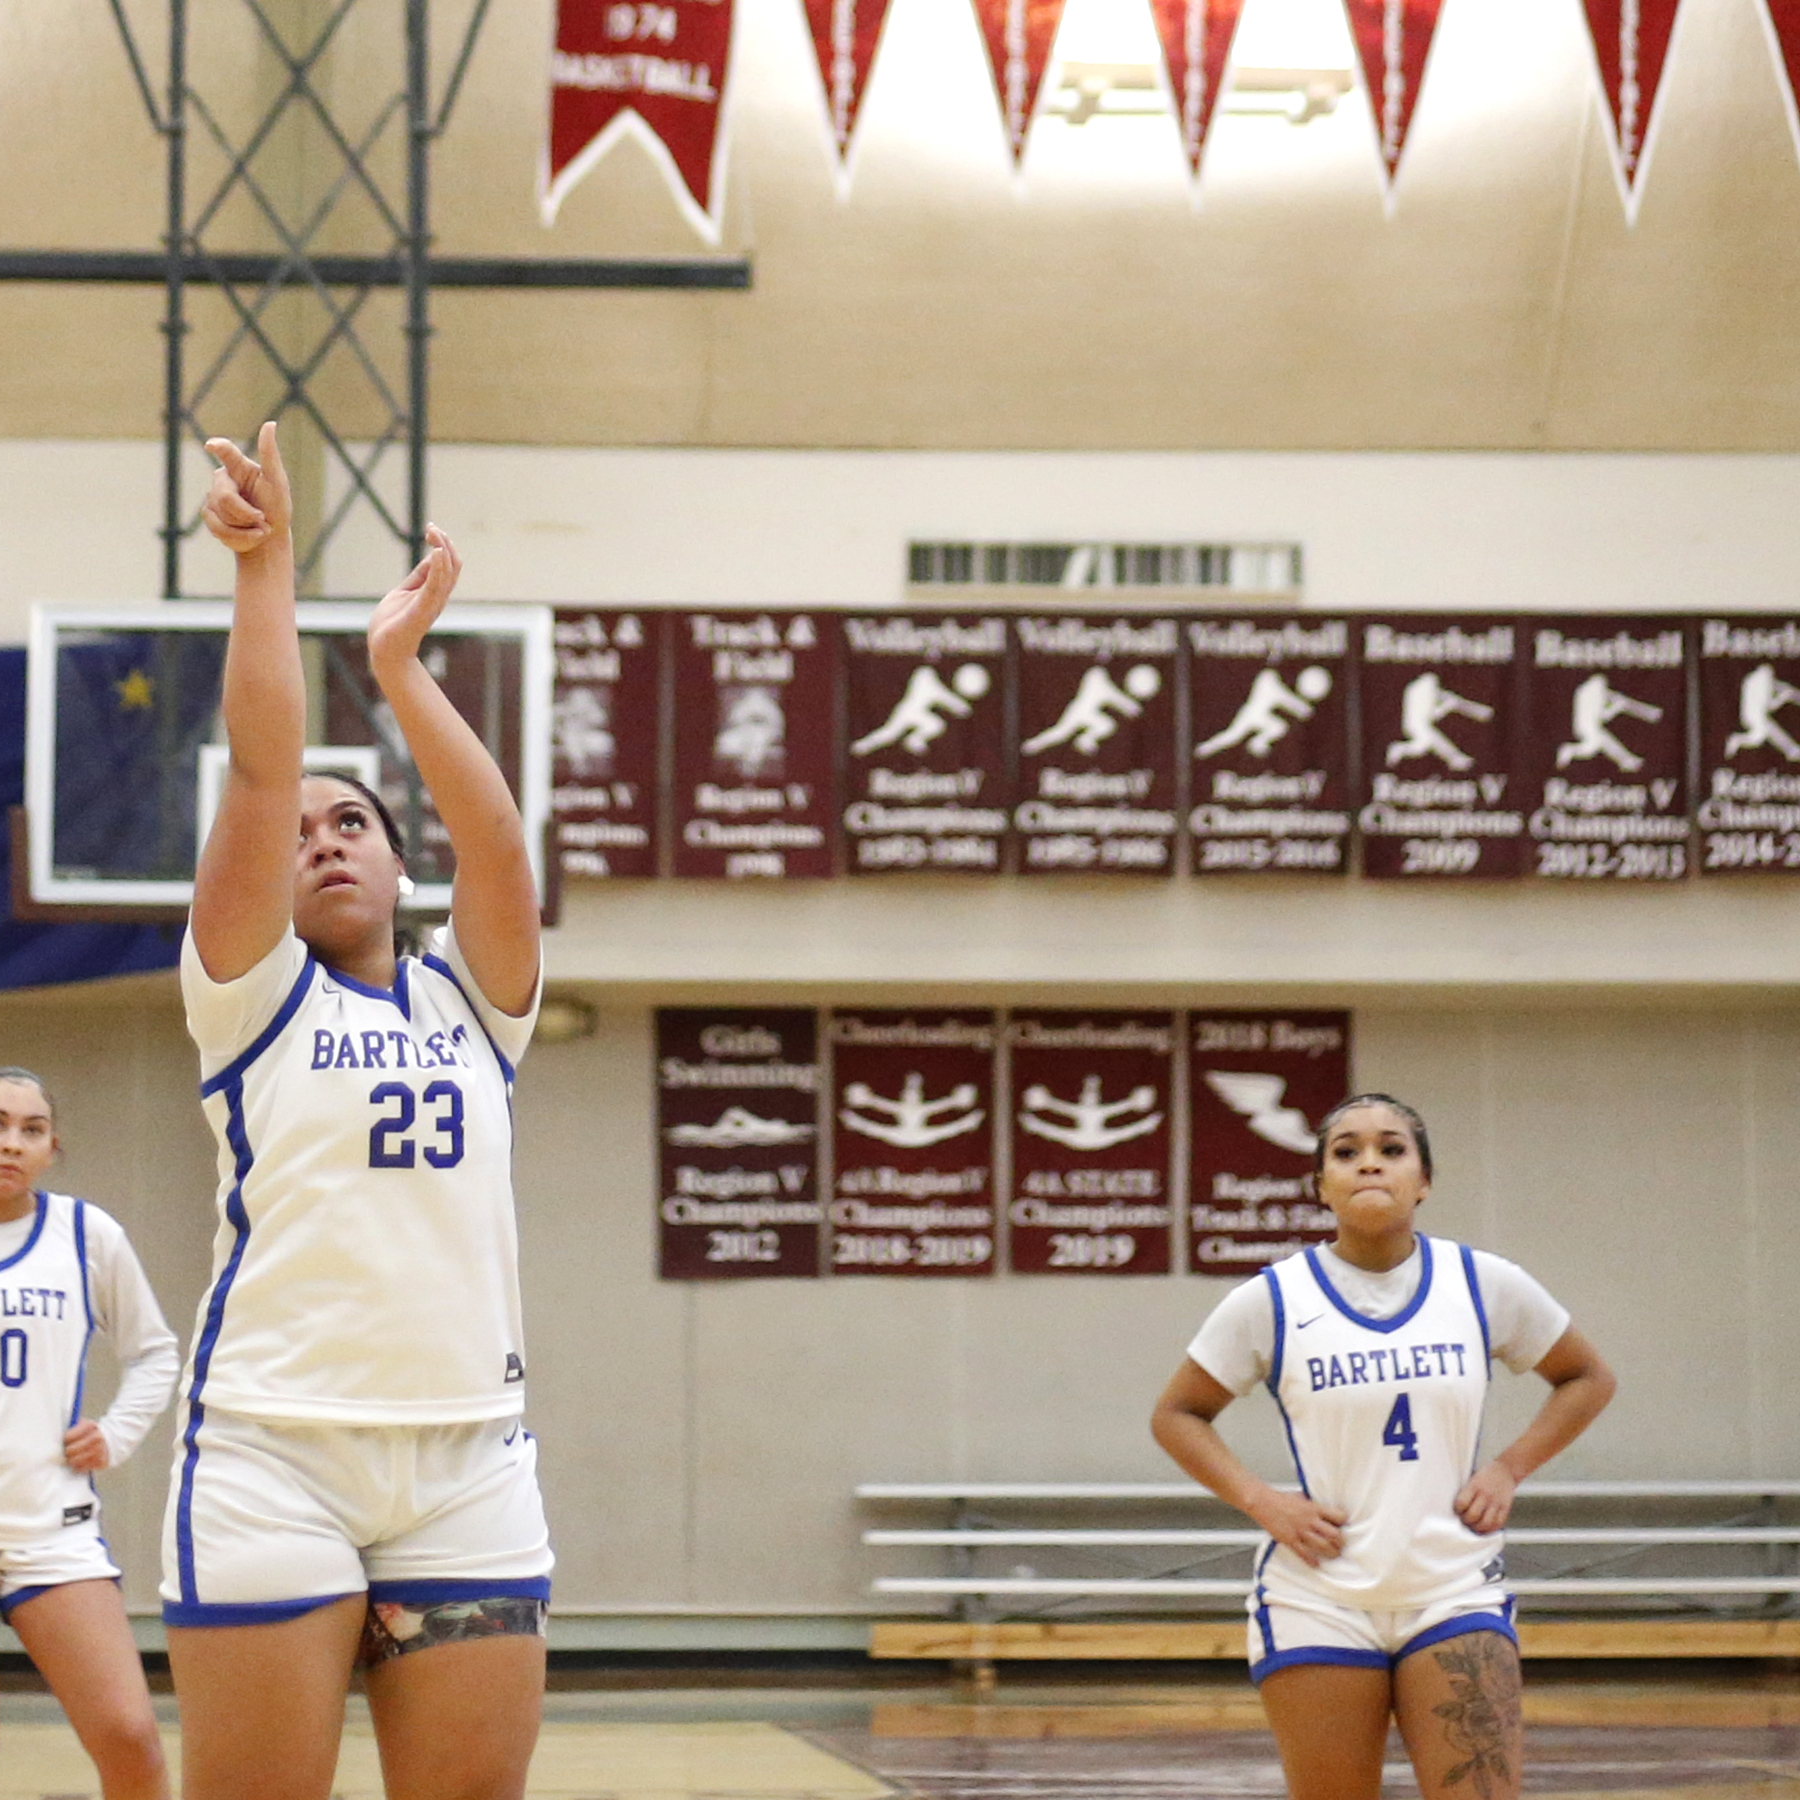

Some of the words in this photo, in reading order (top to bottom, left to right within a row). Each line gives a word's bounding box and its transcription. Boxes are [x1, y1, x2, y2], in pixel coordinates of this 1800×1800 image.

[844, 617, 1006, 663] Volleyball
[1016, 618, 1179, 664] Volleyball
[1189, 620, 1348, 665] Volleyball
[1364, 624, 1514, 664] Baseball
[1535, 629, 1683, 669] Baseball
[1373, 774, 1478, 809] Region
[1479, 774, 1507, 804] V
[1544, 778, 1646, 814] Region
[1650, 778, 1678, 810] V
[1359, 803, 1523, 839] Champions
[1528, 807, 1690, 844] Champions
[1402, 838, 1480, 873] 2009
[369, 1080, 464, 1169] 23
[676, 1165, 778, 1200] Region
[660, 1196, 824, 1228] Champions
[828, 1198, 992, 1231] Champions
[1009, 1198, 1171, 1233] Champions
[1048, 1234, 1136, 1267] 2019
[1307, 1343, 1466, 1392] BARTLETT
[1381, 1391, 1419, 1461] 4
